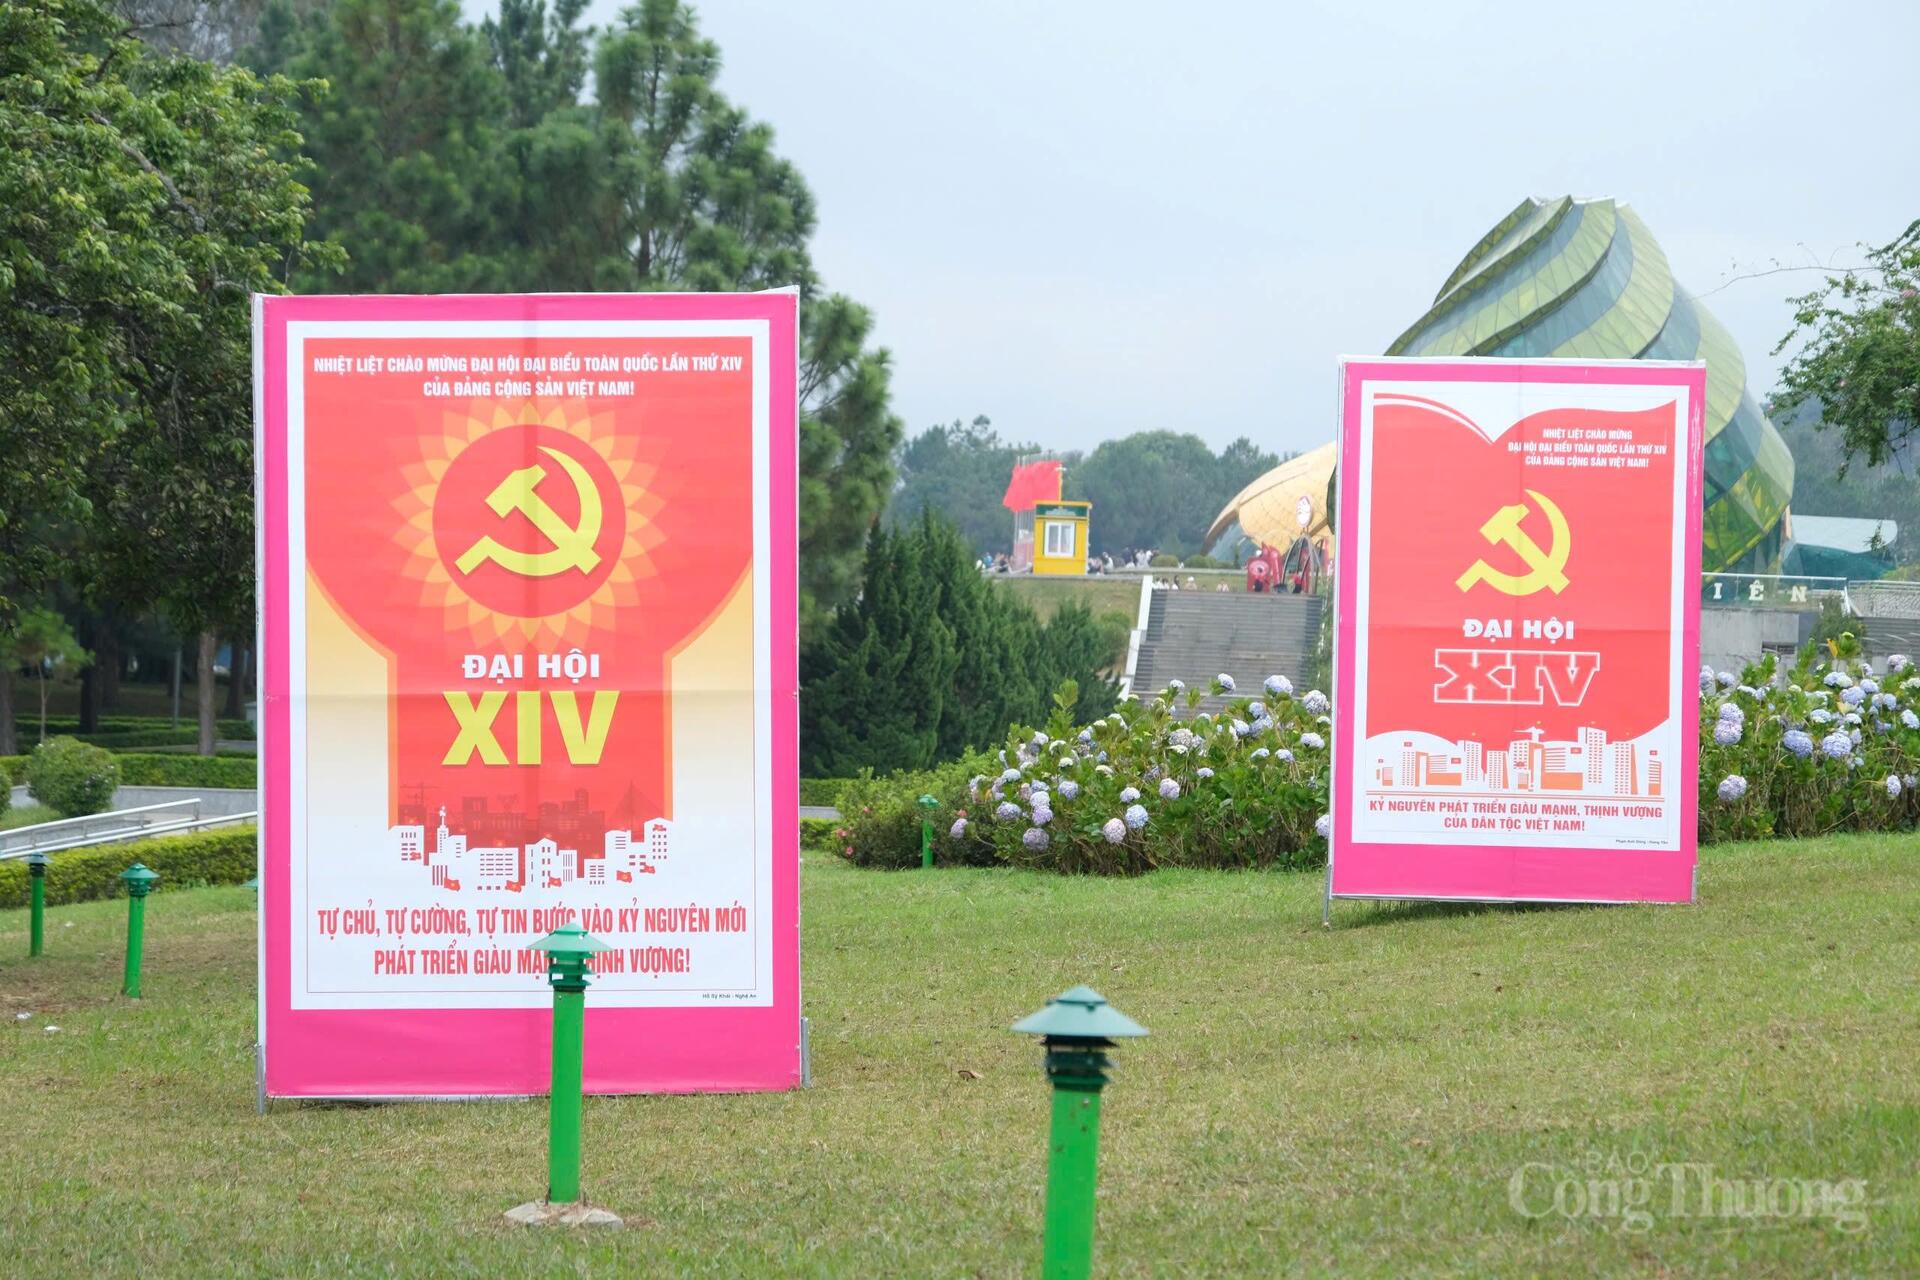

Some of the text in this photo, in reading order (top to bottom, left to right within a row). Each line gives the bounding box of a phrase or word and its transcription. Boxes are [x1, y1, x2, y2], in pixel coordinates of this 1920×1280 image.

[314, 355, 352, 375] NHIỆT
[357, 355, 383, 375] LIỆT
[388, 354, 423, 372] CHÀO
[427, 354, 467, 372] MỪNG
[471, 356, 493, 375] ĐẠI
[498, 354, 519, 375] HỘI
[523, 356, 546, 375] ĐẠI
[550, 352, 580, 371] BIỂU
[584, 353, 619, 371] TOÀN
[623, 352, 658, 372] QUỐC
[692, 353, 718, 371] THỨ
[720, 356, 743, 371] XIV
[423, 375, 634, 399] CỦA ĐẢNG CỘNG SẢN VIỆT NAM!
[1543, 428, 1632, 441] NHIỆT LIỆT CHÀO MỪNG
[1508, 443, 1521, 453] ĐẠI
[1523, 442, 1537, 454] HỘI
[1538, 443, 1552, 454] ĐẠI
[1554, 441, 1572, 453] BIỂU
[1575, 442, 1594, 453] TOÀN
[1597, 442, 1617, 454] QUỐC
[1637, 443, 1654, 454] THỨ
[1654, 445, 1667, 455] XIV
[1525, 453, 1648, 468] CỦA ĐẢNG CỘNG SẢN VIỆT NAM!
[1463, 616, 1574, 644] ĐẠI HỘI
[462, 648, 600, 684] ĐẠI HỘI
[1434, 648, 1600, 706] XIV
[441, 690, 620, 765] XIV
[1370, 796, 1662, 820] KỶ NGUYÊN PHÁT TRIỂN GIÀU MẠNH, THỊNH VƯỢNG
[1444, 813, 1585, 832] CỦA DÂN TỘC VIỆT NAM!
[318, 907, 339, 940] TỰ
[343, 898, 380, 937] CHỦ,
[385, 907, 407, 940] TỰ
[411, 902, 471, 936] CƯỜNG,
[477, 906, 498, 939] TỰ
[501, 909, 527, 934] TIN
[582, 903, 613, 932] VÀO
[619, 897, 639, 932] KỶ
[645, 903, 709, 932] NGUYÊN
[715, 900, 746, 932] MỚI
[374, 944, 416, 974] PHÁT
[421, 939, 468, 974] TRIỂN
[473, 944, 511, 974] GIÀU
[630, 945, 690, 979] VƯỢNG!
